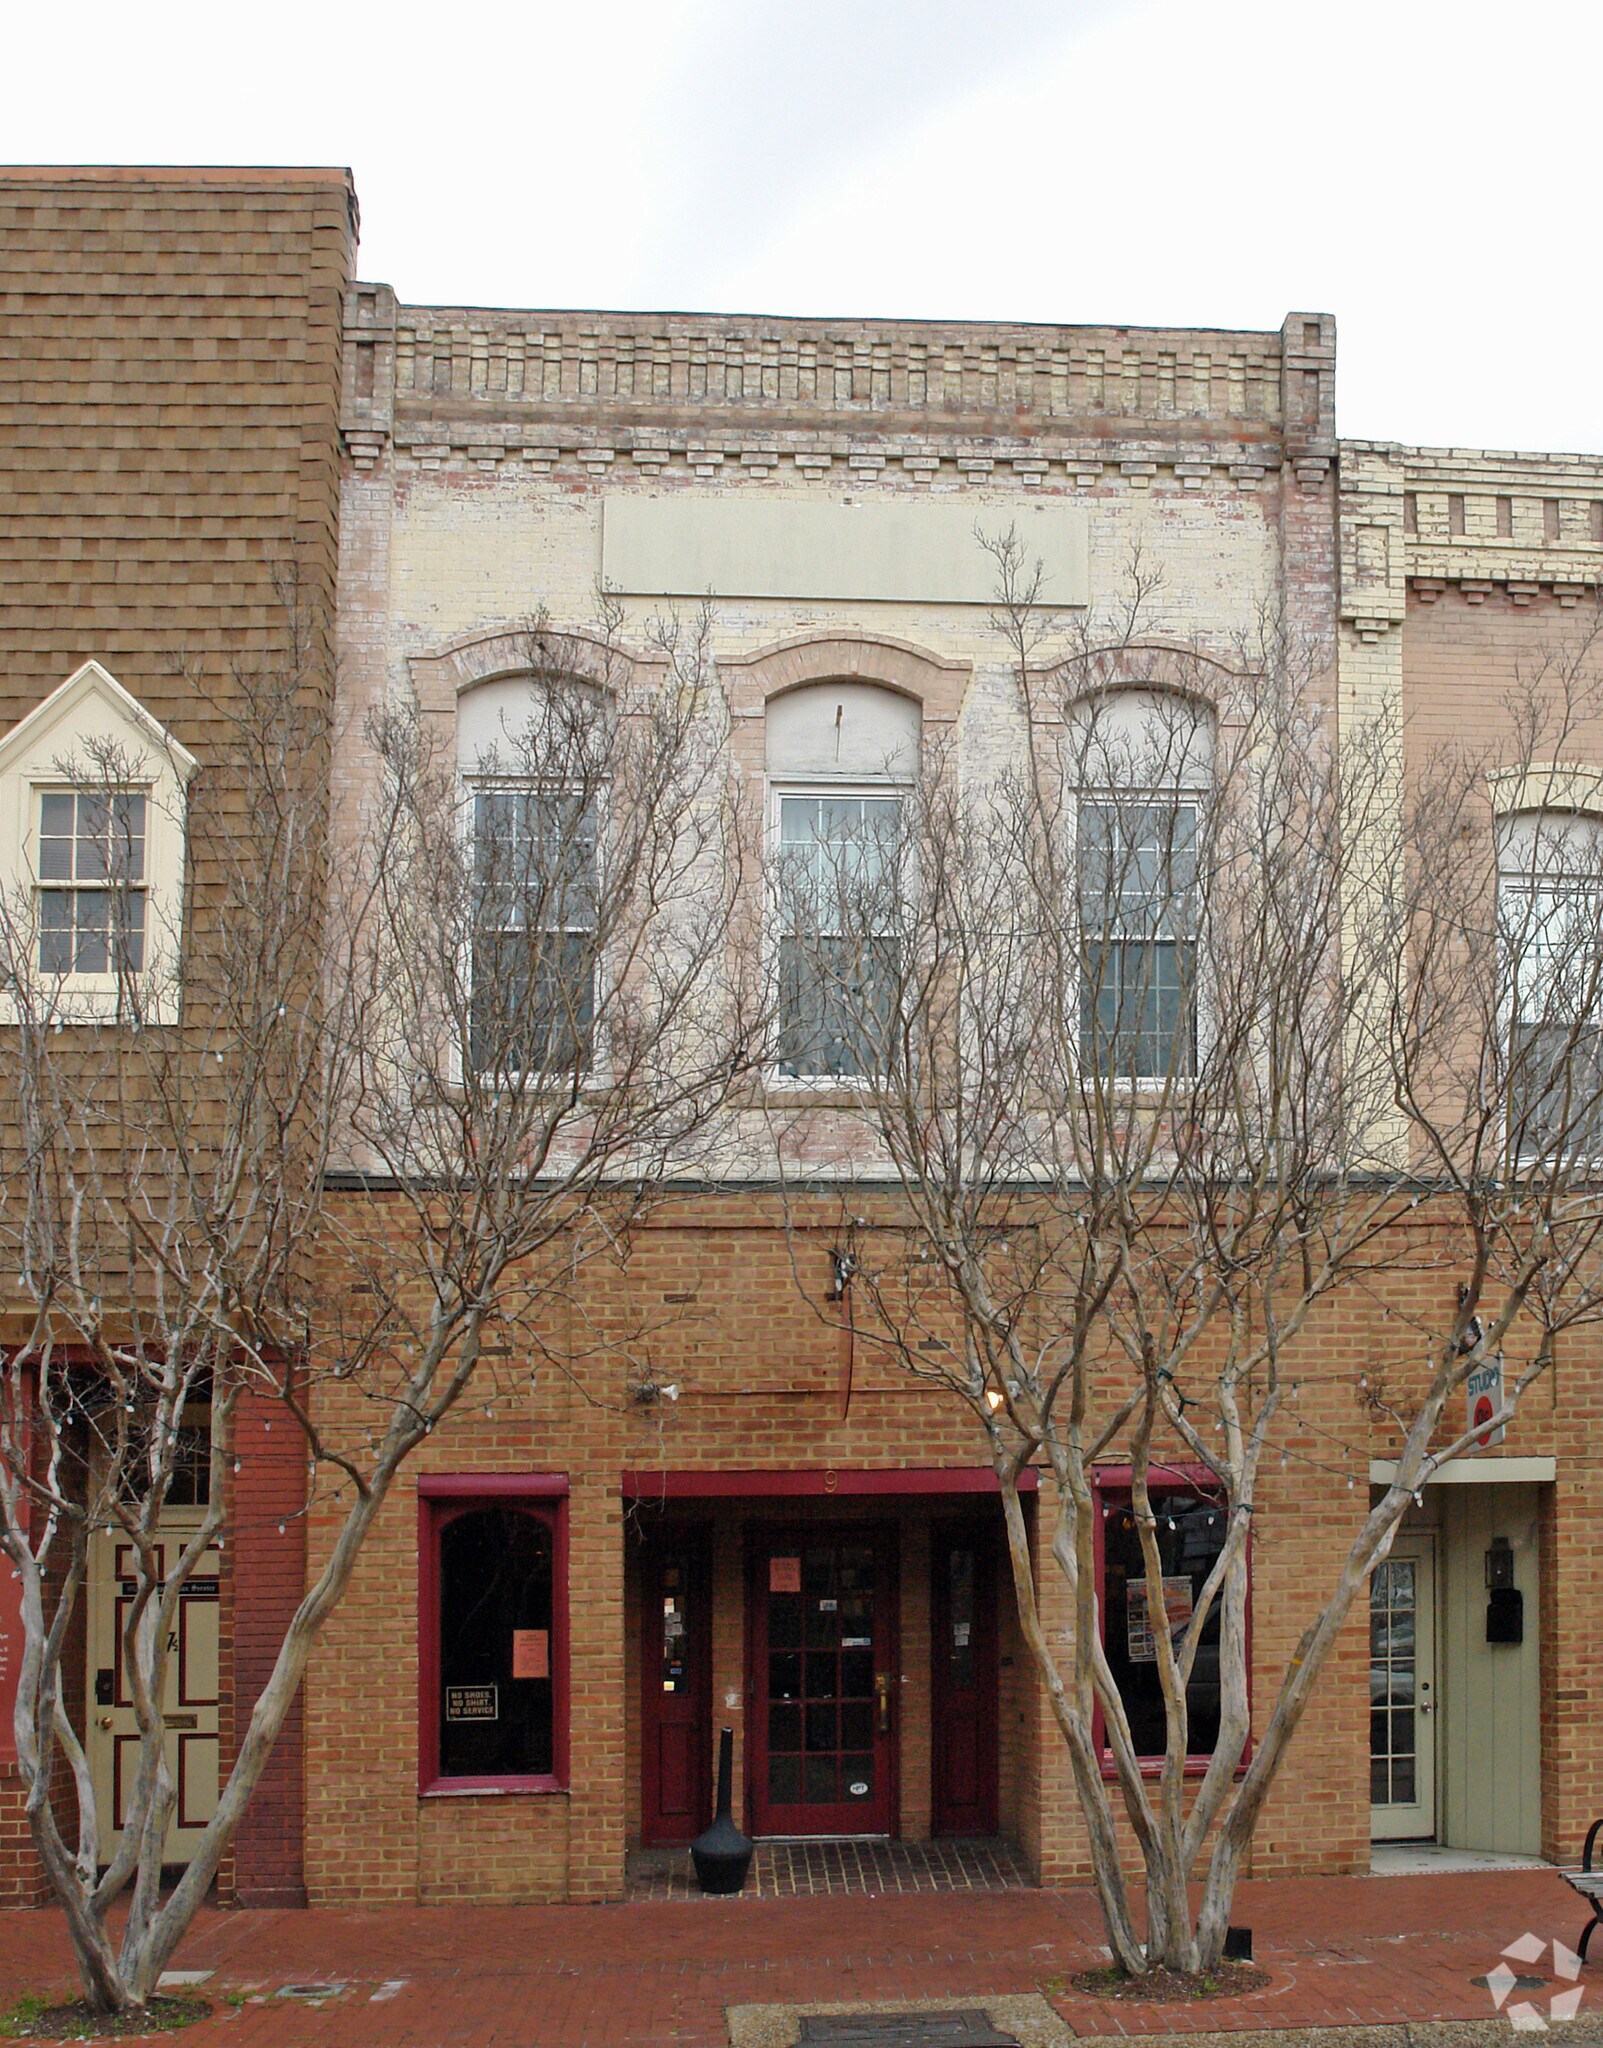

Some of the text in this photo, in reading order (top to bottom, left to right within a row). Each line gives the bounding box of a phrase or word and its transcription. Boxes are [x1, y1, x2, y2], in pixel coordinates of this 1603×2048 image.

[824, 1471, 838, 1493] 9
[451, 1691, 463, 1700] NO
[452, 1699, 464, 1707] NO
[450, 1706, 494, 1715] NO SERVICE
